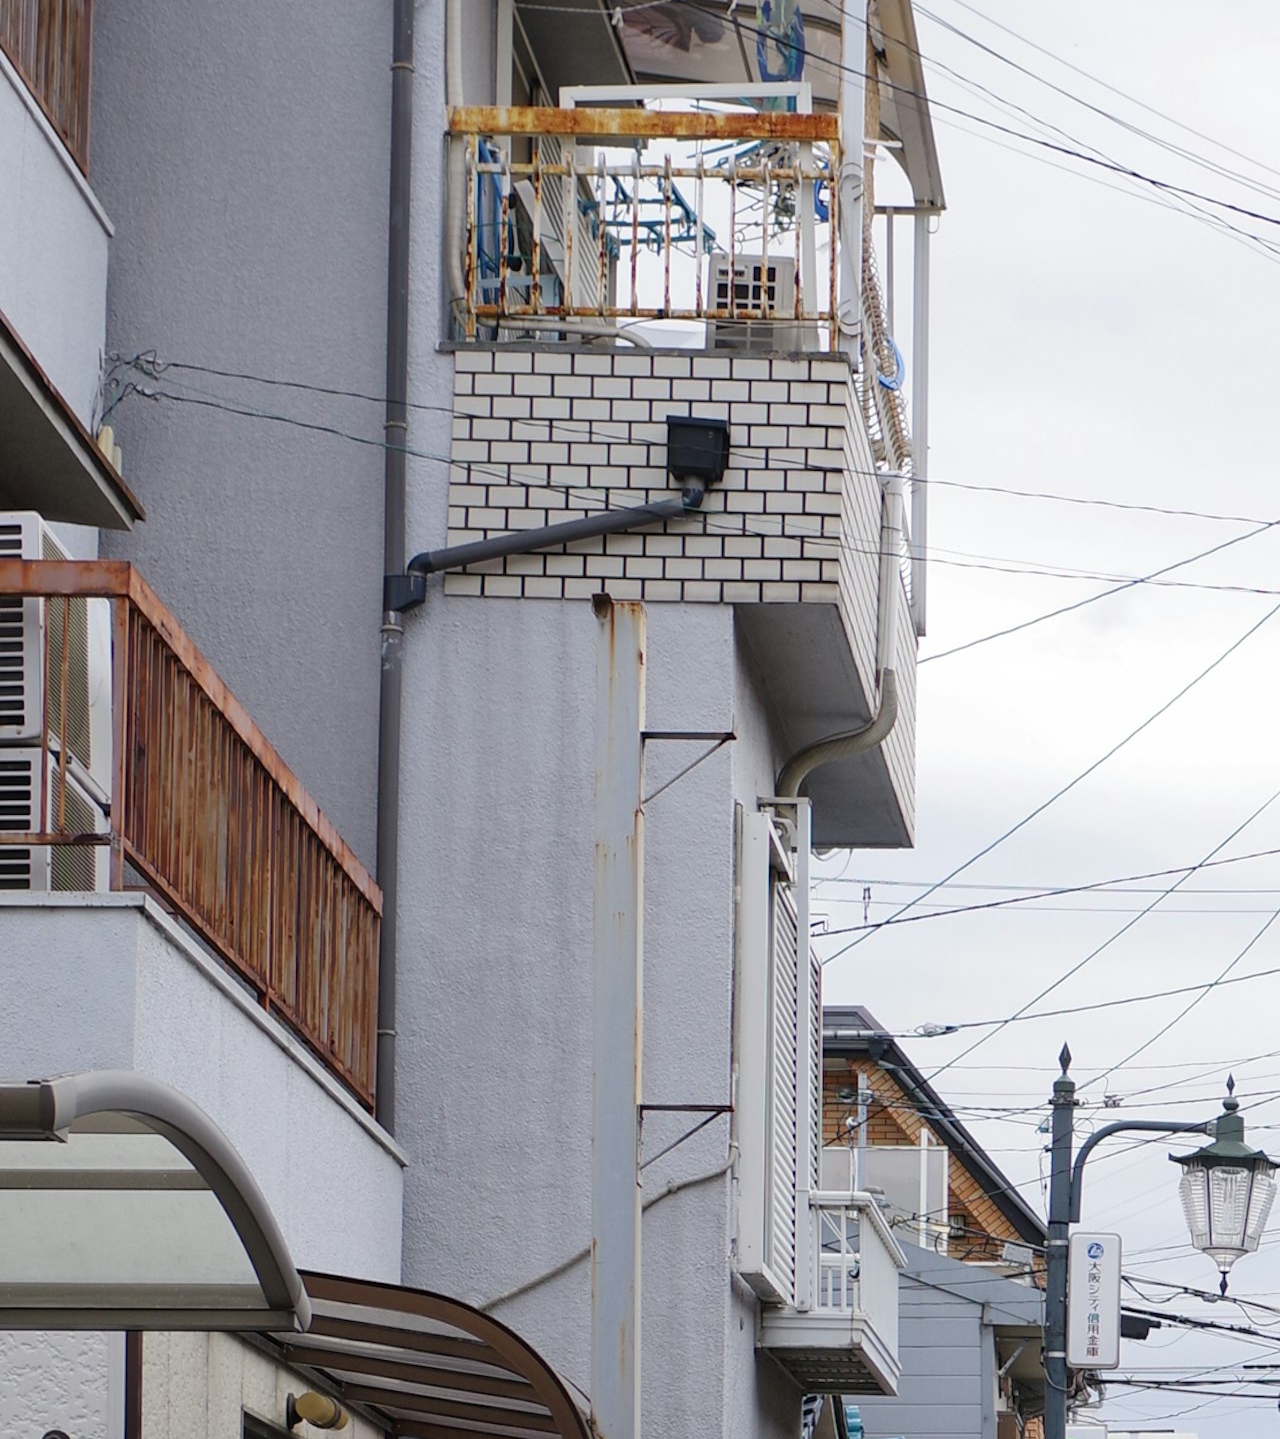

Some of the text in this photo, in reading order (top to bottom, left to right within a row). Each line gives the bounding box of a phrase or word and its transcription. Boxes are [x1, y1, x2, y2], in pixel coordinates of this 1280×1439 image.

[1086, 1261, 1101, 1358] 大阪シティ信用金庫
